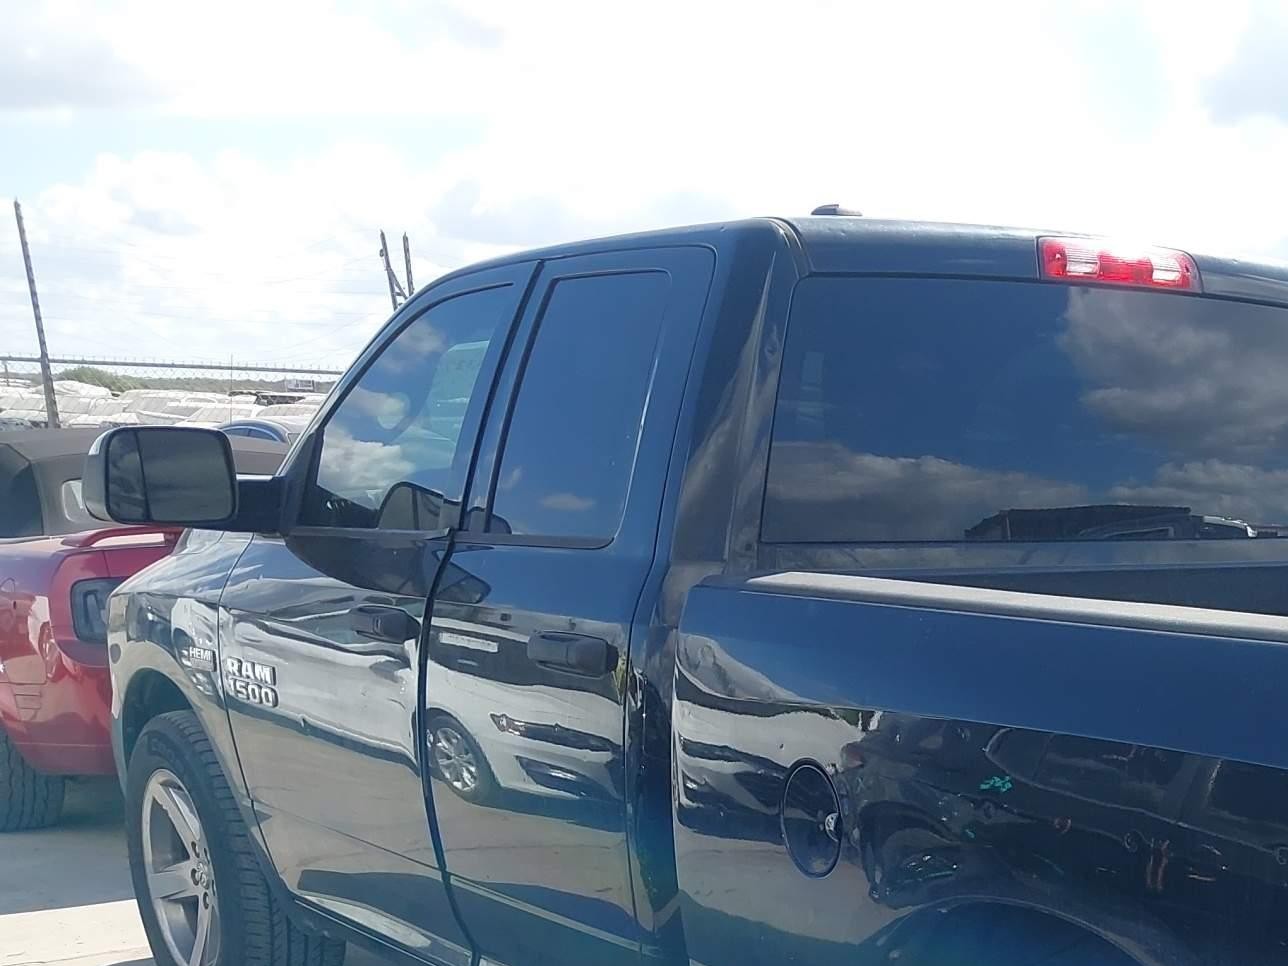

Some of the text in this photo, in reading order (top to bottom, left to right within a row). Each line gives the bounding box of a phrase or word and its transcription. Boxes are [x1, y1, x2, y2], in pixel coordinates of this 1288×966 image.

[189, 646, 212, 661] HEMI
[226, 656, 275, 685] RAM
[226, 677, 278, 708] 1500
